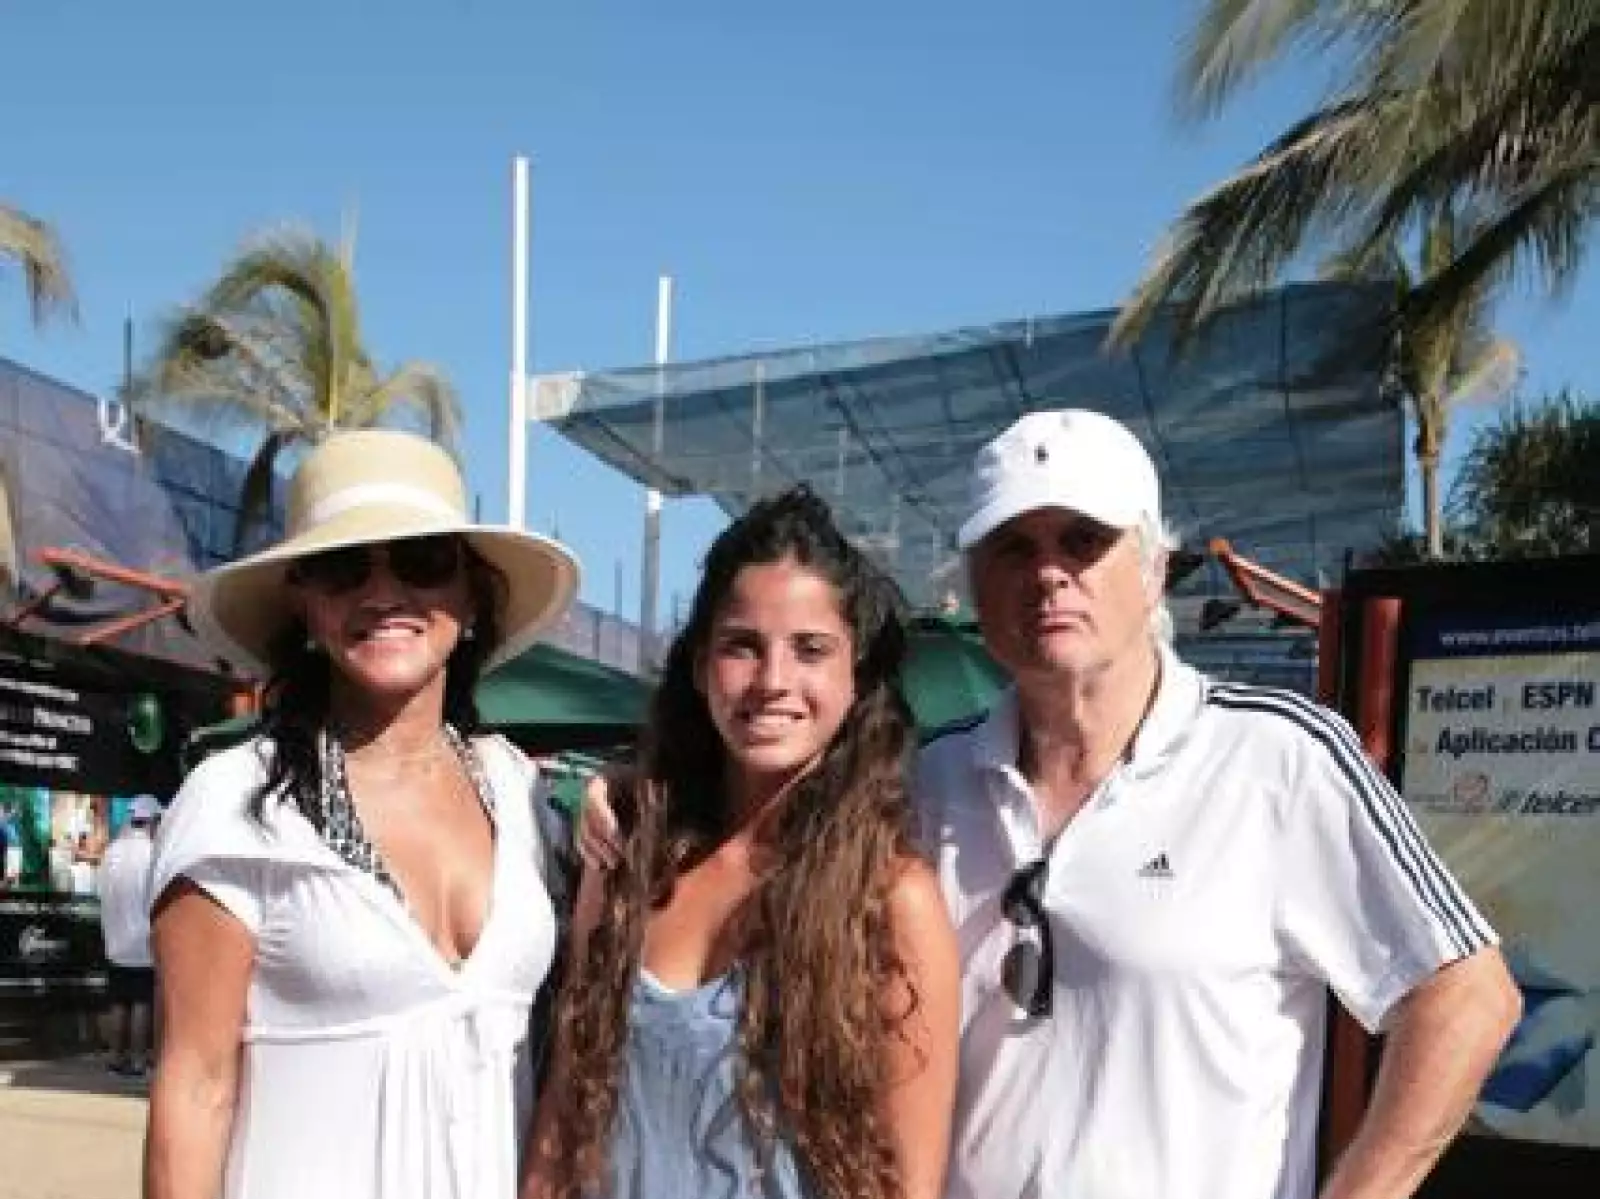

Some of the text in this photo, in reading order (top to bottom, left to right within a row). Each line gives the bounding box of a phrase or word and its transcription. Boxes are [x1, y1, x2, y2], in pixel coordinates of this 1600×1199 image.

[1416, 682, 1596, 713] Telcel ESPN
[1436, 727, 1577, 760] Aplicación
